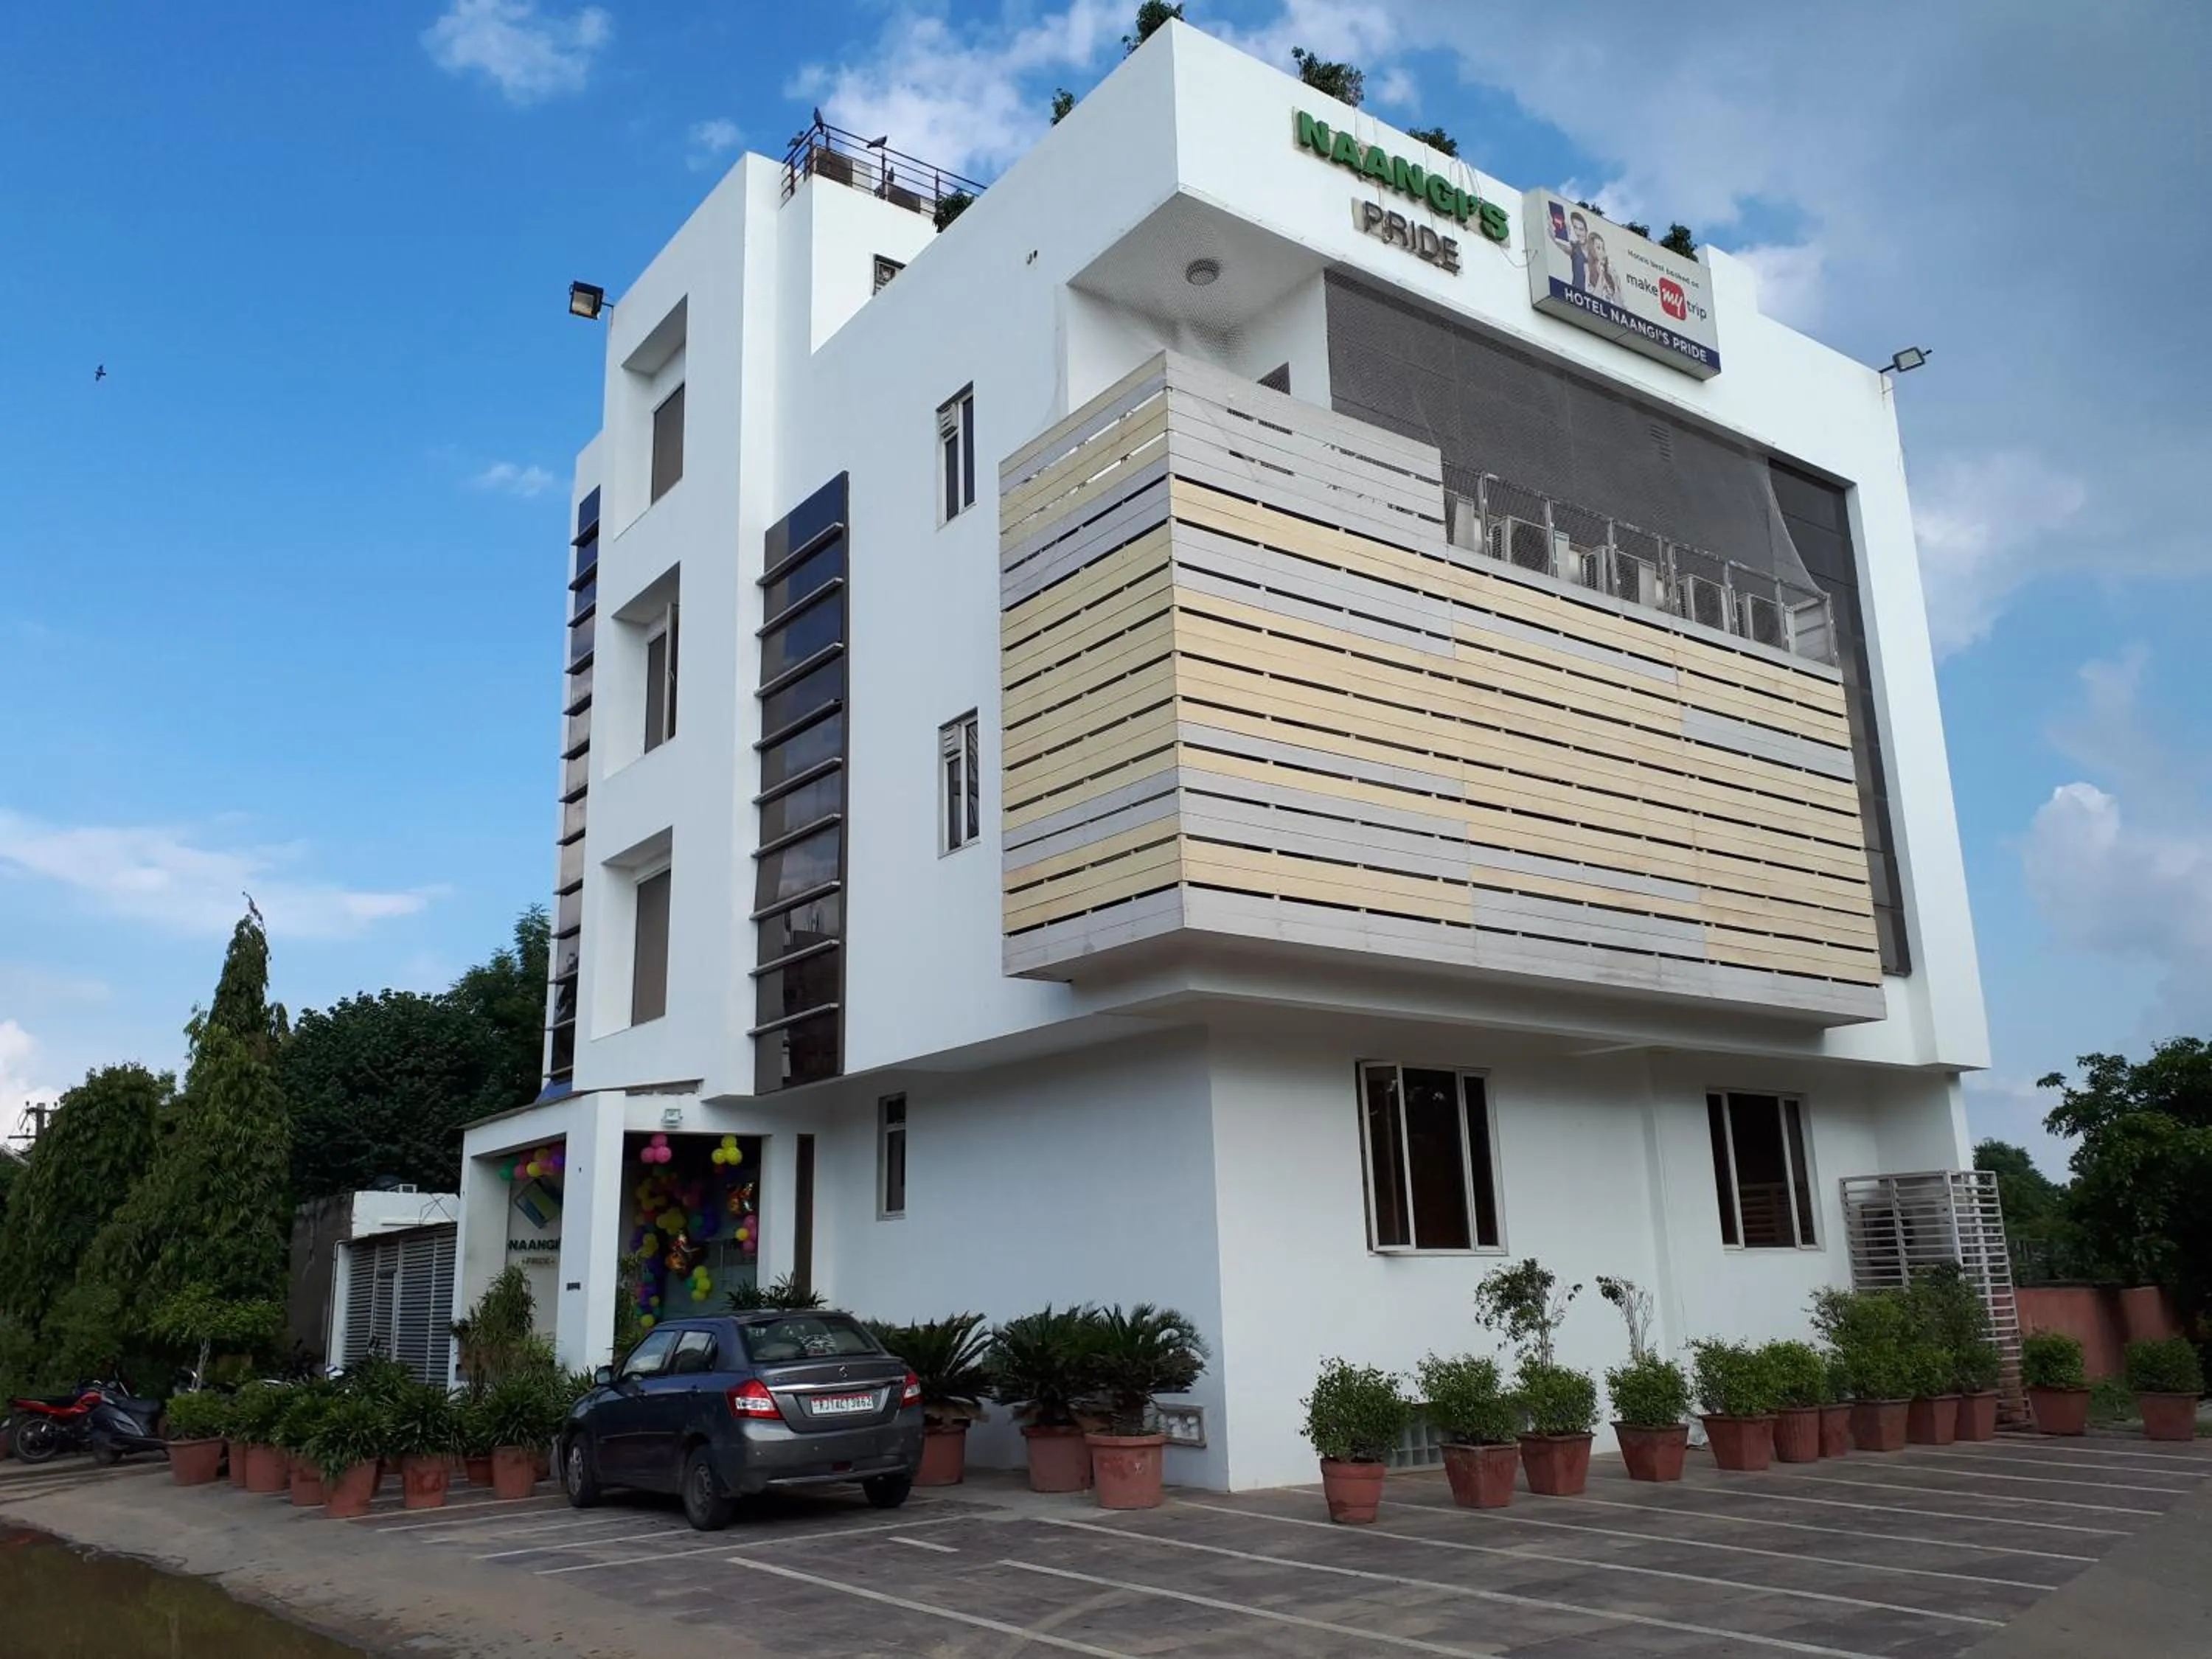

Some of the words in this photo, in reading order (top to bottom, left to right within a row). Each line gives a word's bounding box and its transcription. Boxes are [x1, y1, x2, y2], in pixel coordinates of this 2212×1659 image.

[1297, 111, 1509, 241] NAANGI'S
[1364, 200, 1461, 275] PRIDE
[1564, 287, 1607, 318] HOTEL
[1610, 308, 1670, 345] NAANGI'S
[1672, 336, 1708, 362] PRIDE
[1626, 273, 1658, 296] make
[1686, 300, 1707, 321] trip
